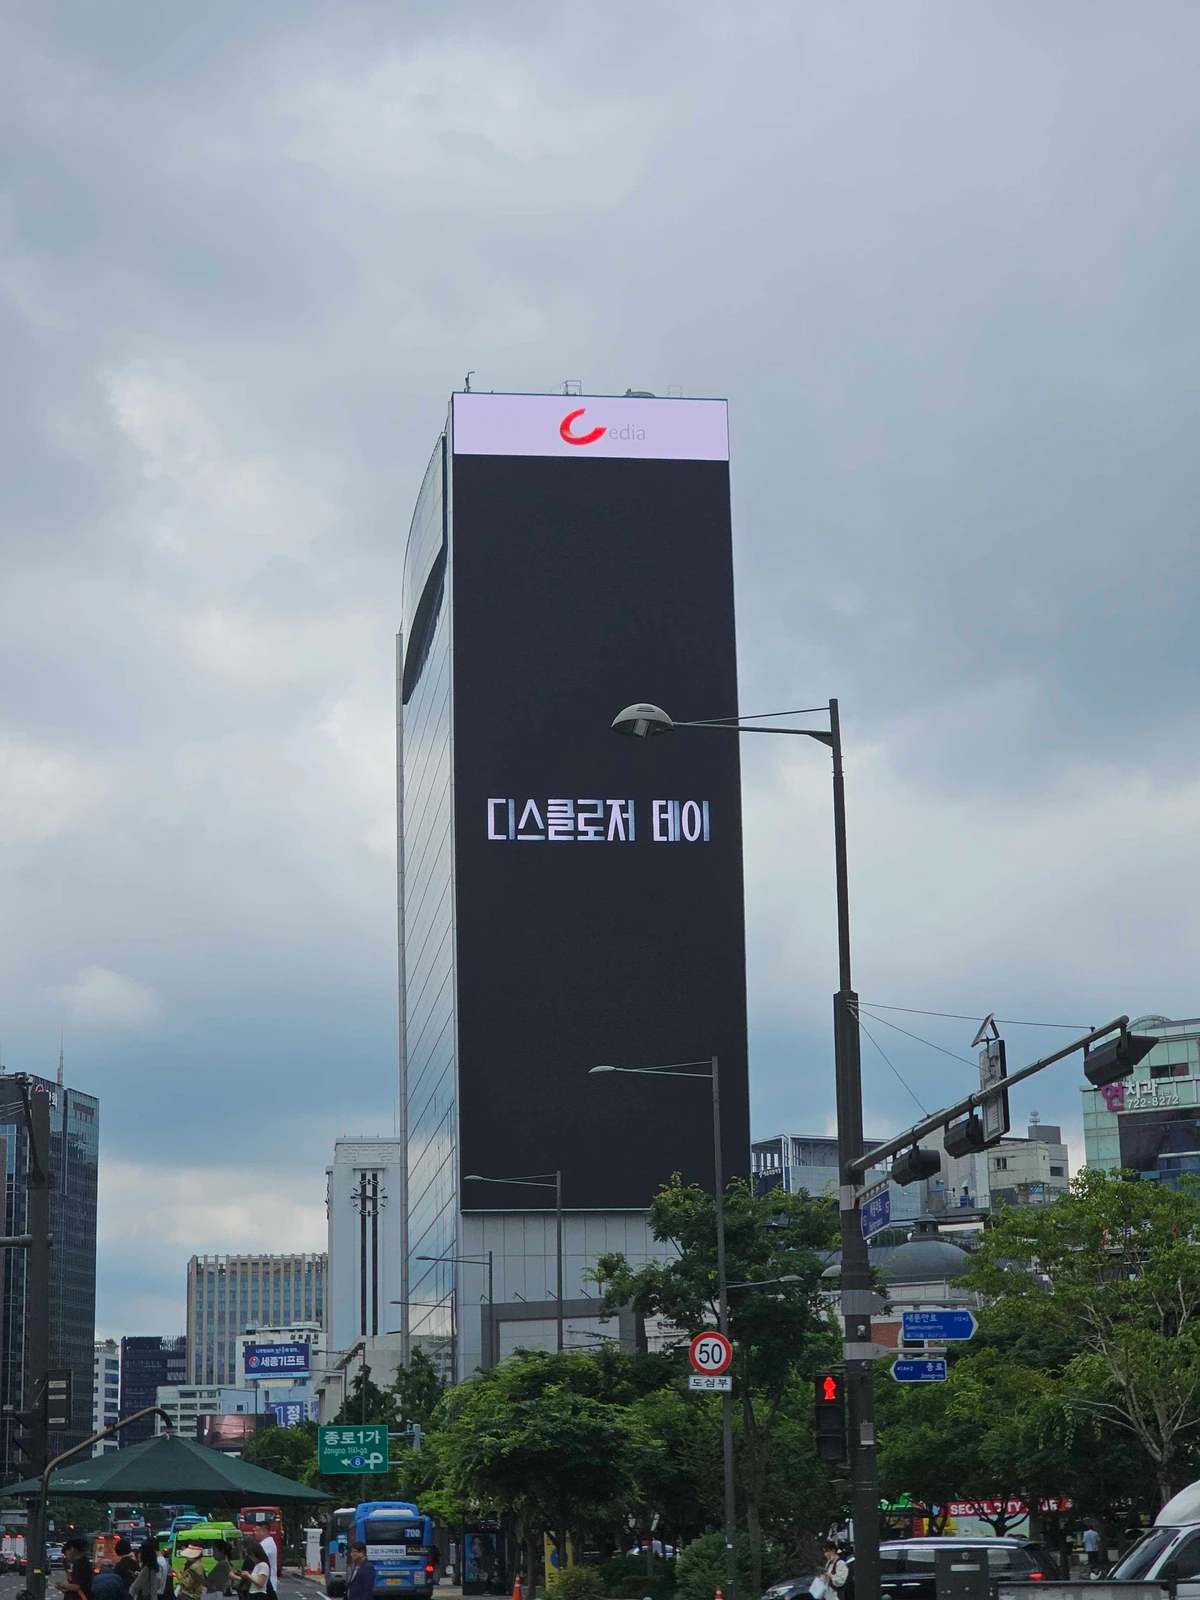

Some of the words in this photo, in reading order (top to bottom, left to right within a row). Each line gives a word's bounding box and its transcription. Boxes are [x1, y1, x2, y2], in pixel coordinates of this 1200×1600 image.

[487, 798, 636, 842] 디스클로저
[652, 800, 710, 842] 데이
[1127, 1095, 1179, 1108] 722-8272
[905, 1313, 938, 1323] 새문안로
[698, 1343, 722, 1365] 50
[260, 1355, 306, 1367] 세종기프트
[926, 1362, 944, 1372] 종로
[692, 1378, 729, 1388] 도심부
[324, 1430, 381, 1445] 종로1가
[323, 1447, 346, 1456] Jongno
[355, 1458, 361, 1466] 6
[406, 1529, 420, 1537] 700
